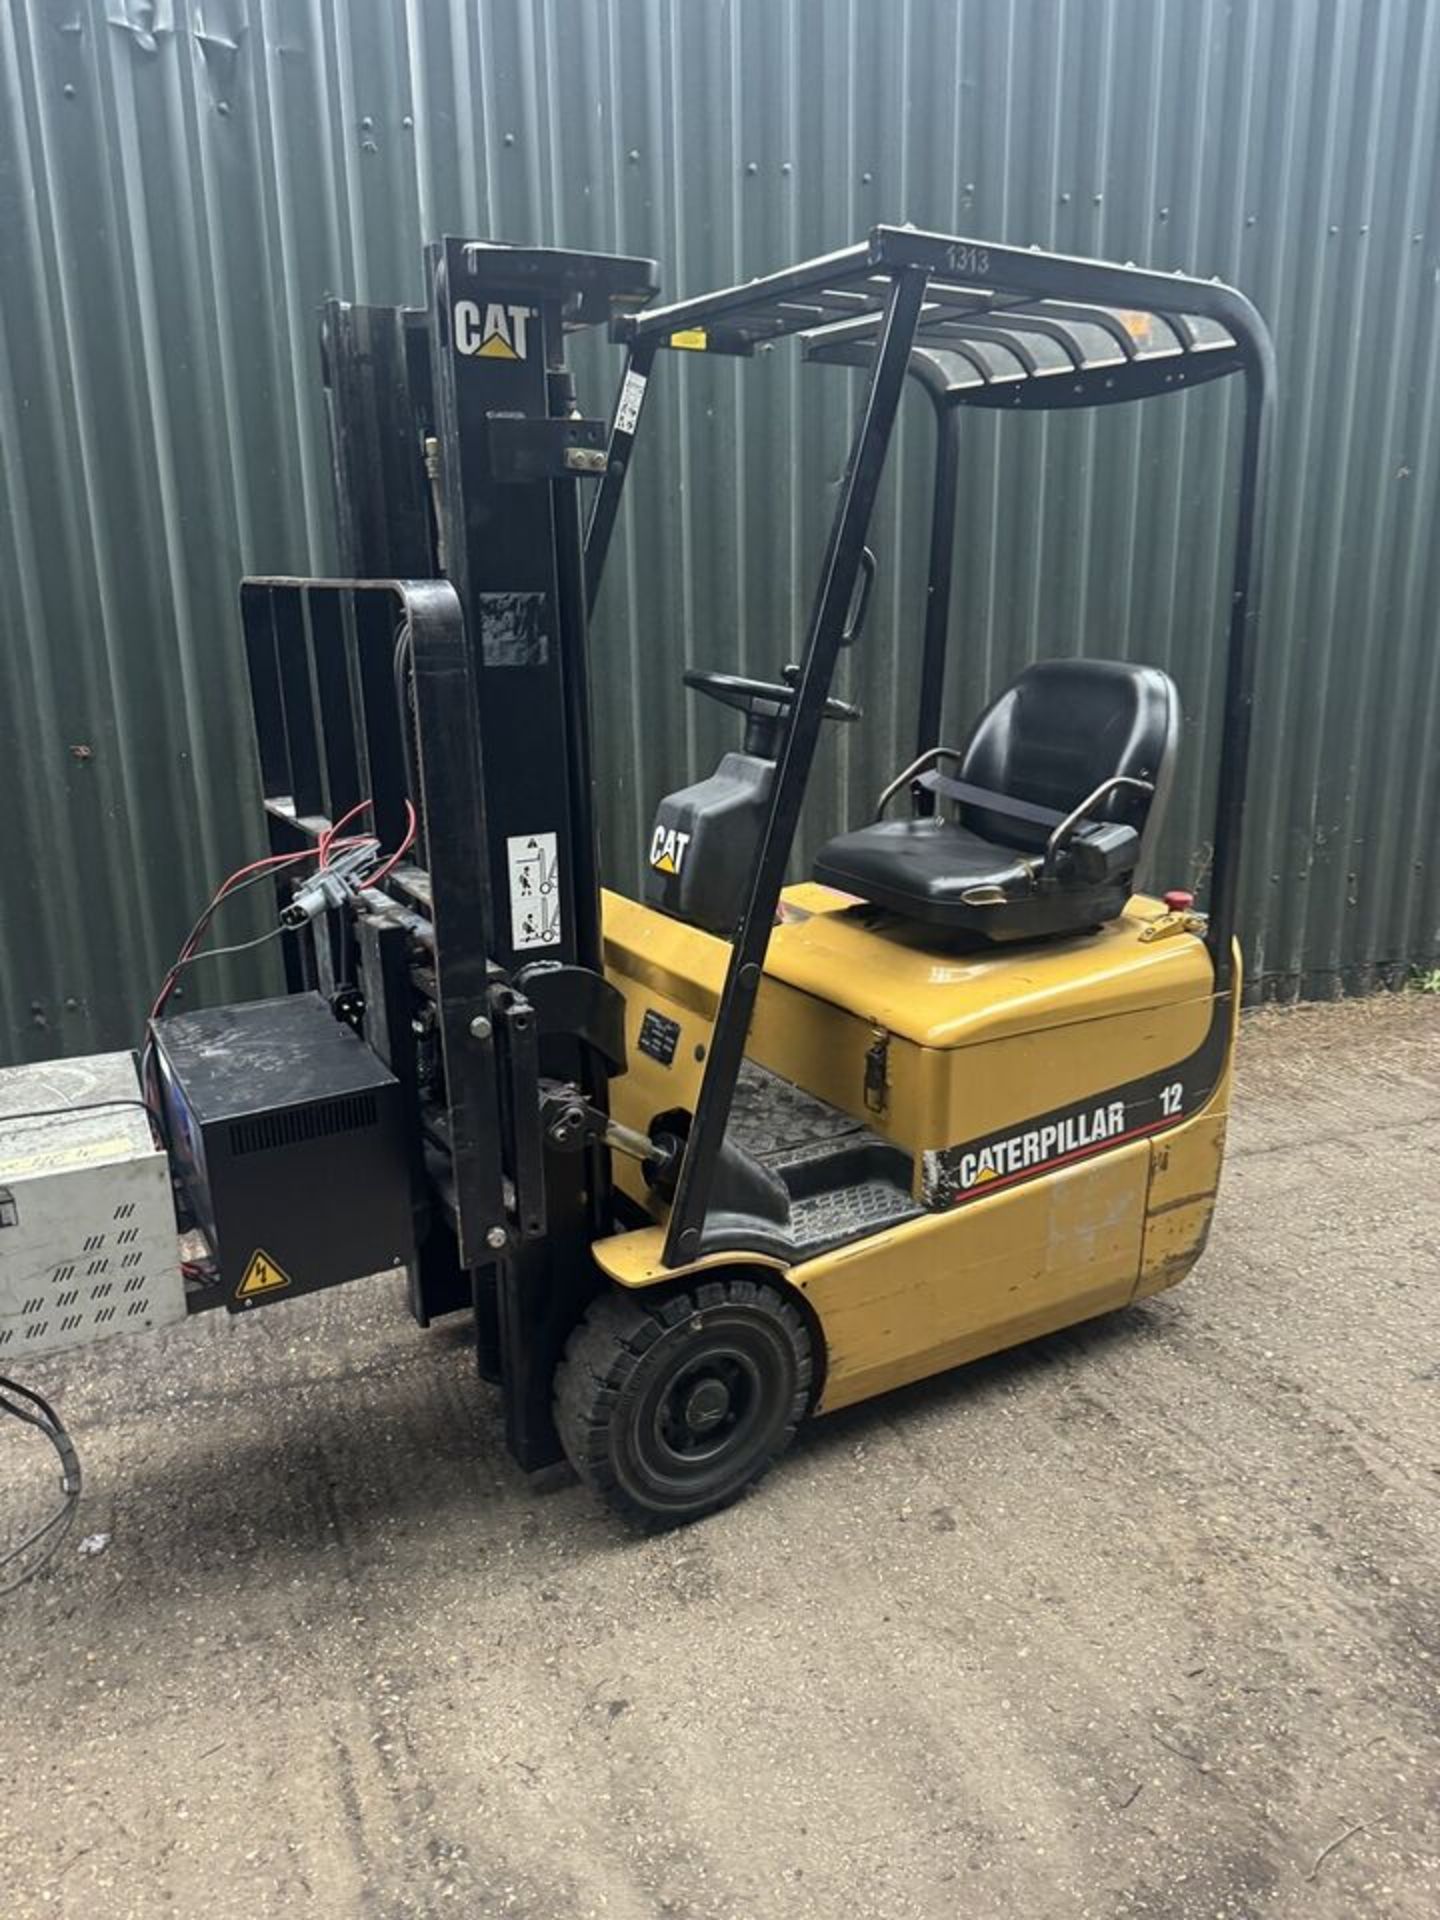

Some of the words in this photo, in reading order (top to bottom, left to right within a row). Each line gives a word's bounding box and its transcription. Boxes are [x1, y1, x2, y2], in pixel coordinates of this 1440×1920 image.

[946, 244, 989, 274] 1313
[455, 300, 529, 359] CAT
[649, 825, 691, 875] CAT
[960, 1101, 1125, 1188] CATERPILLAR
[1159, 1083, 1183, 1115] 12
